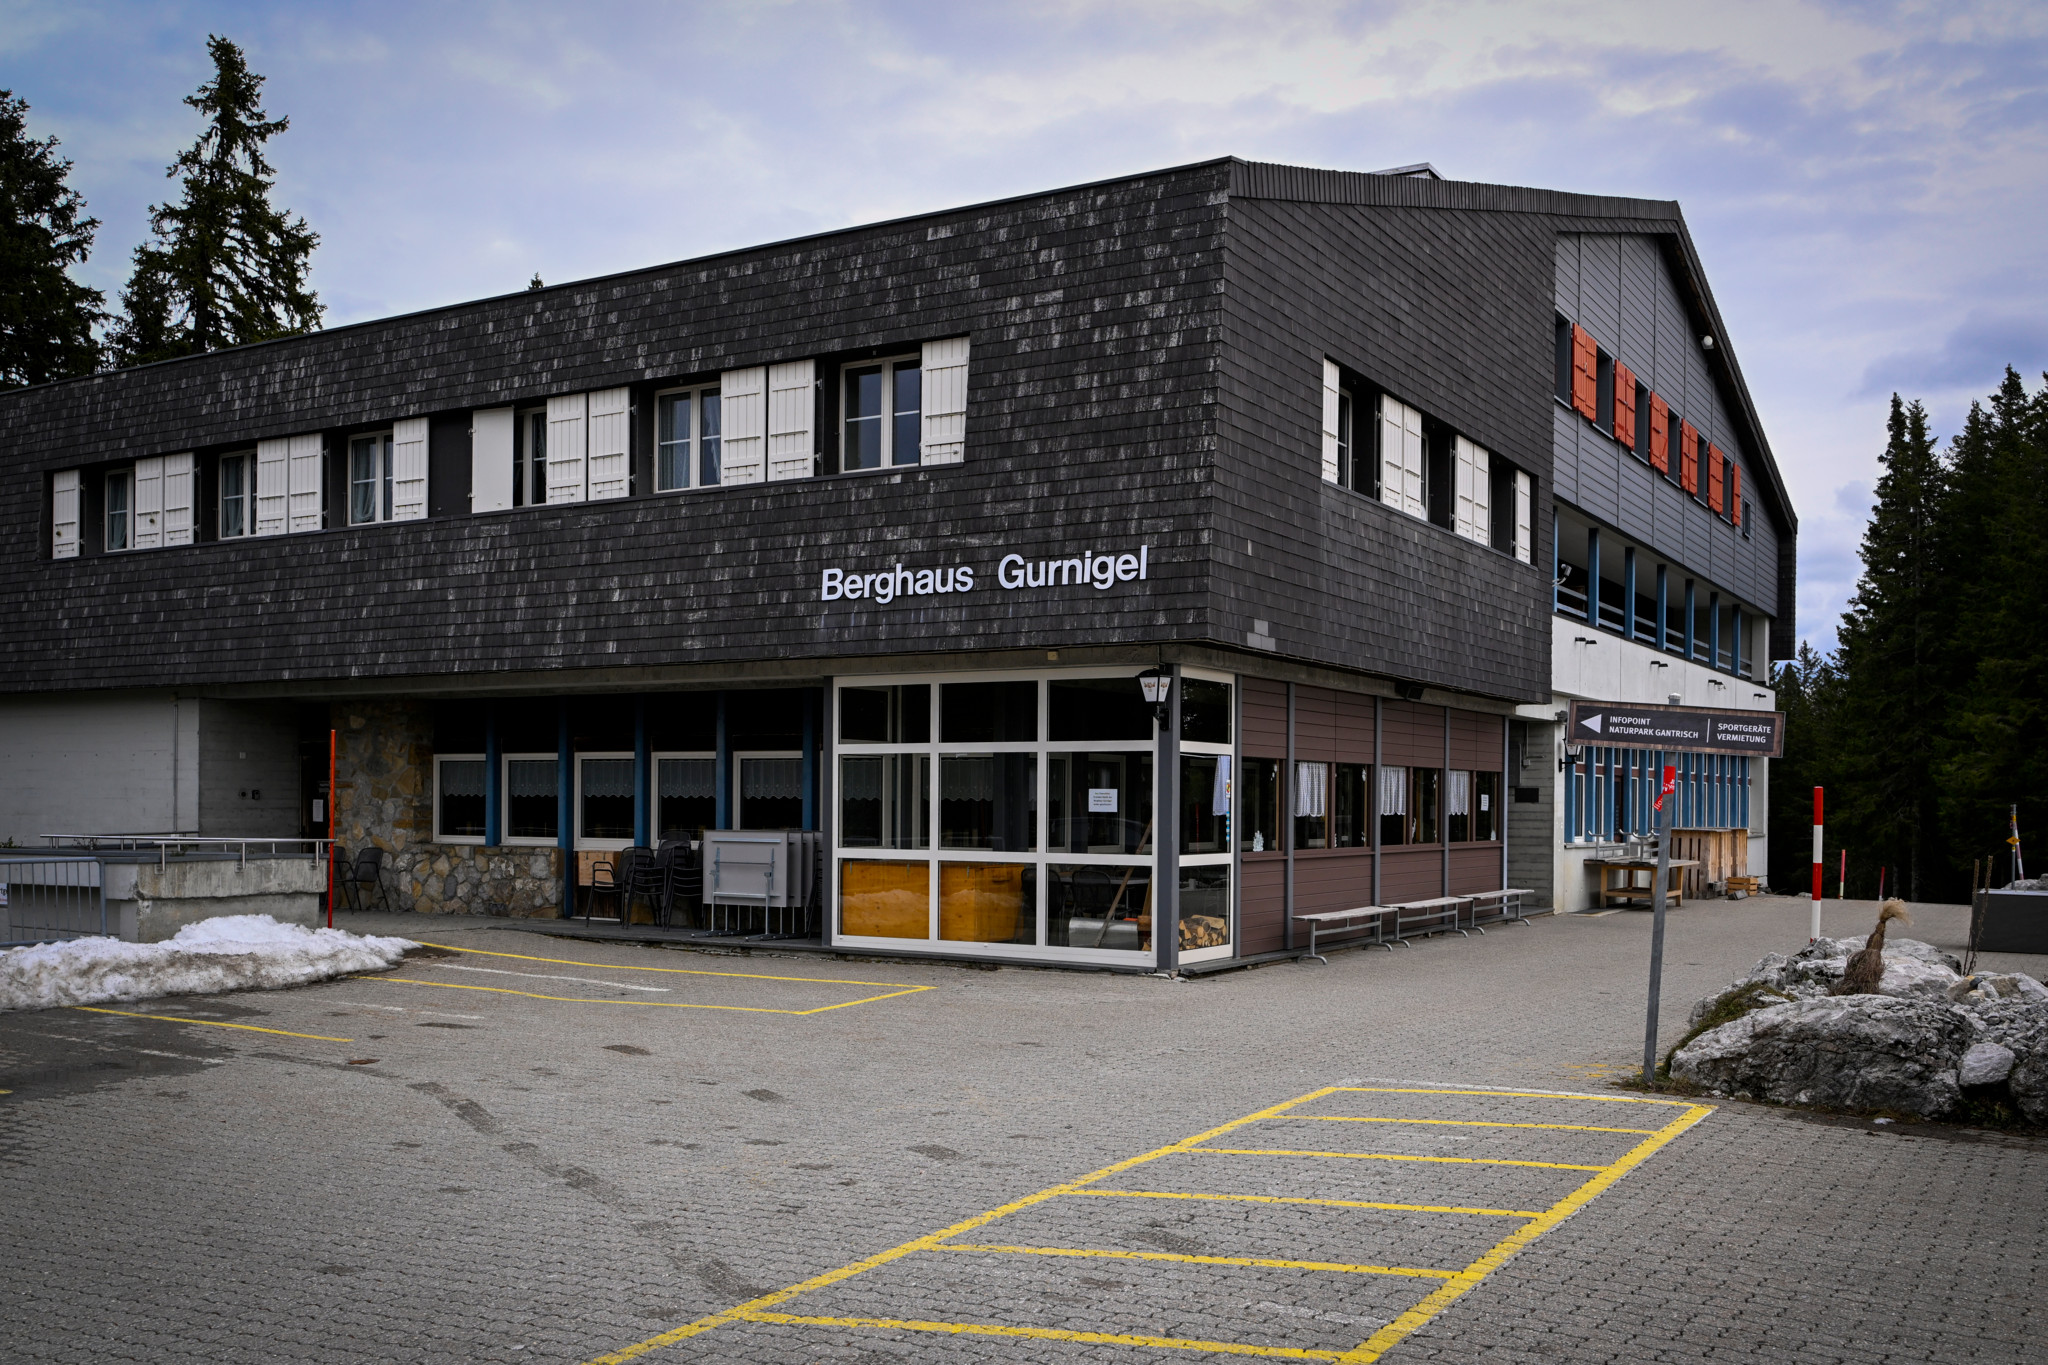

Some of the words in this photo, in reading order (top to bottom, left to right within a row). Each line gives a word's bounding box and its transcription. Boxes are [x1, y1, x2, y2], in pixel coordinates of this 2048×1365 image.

[822, 563, 974, 604] Berghaus
[998, 545, 1148, 589] Gurnigel
[1609, 716, 1651, 725] INFOPOINT
[1609, 726, 1654, 736] NATURPARK
[1655, 729, 1699, 739] GANTRISCH
[1717, 723, 1772, 734] SPORTGERÄTE
[1716, 733, 1767, 744] VERMIETUNG
